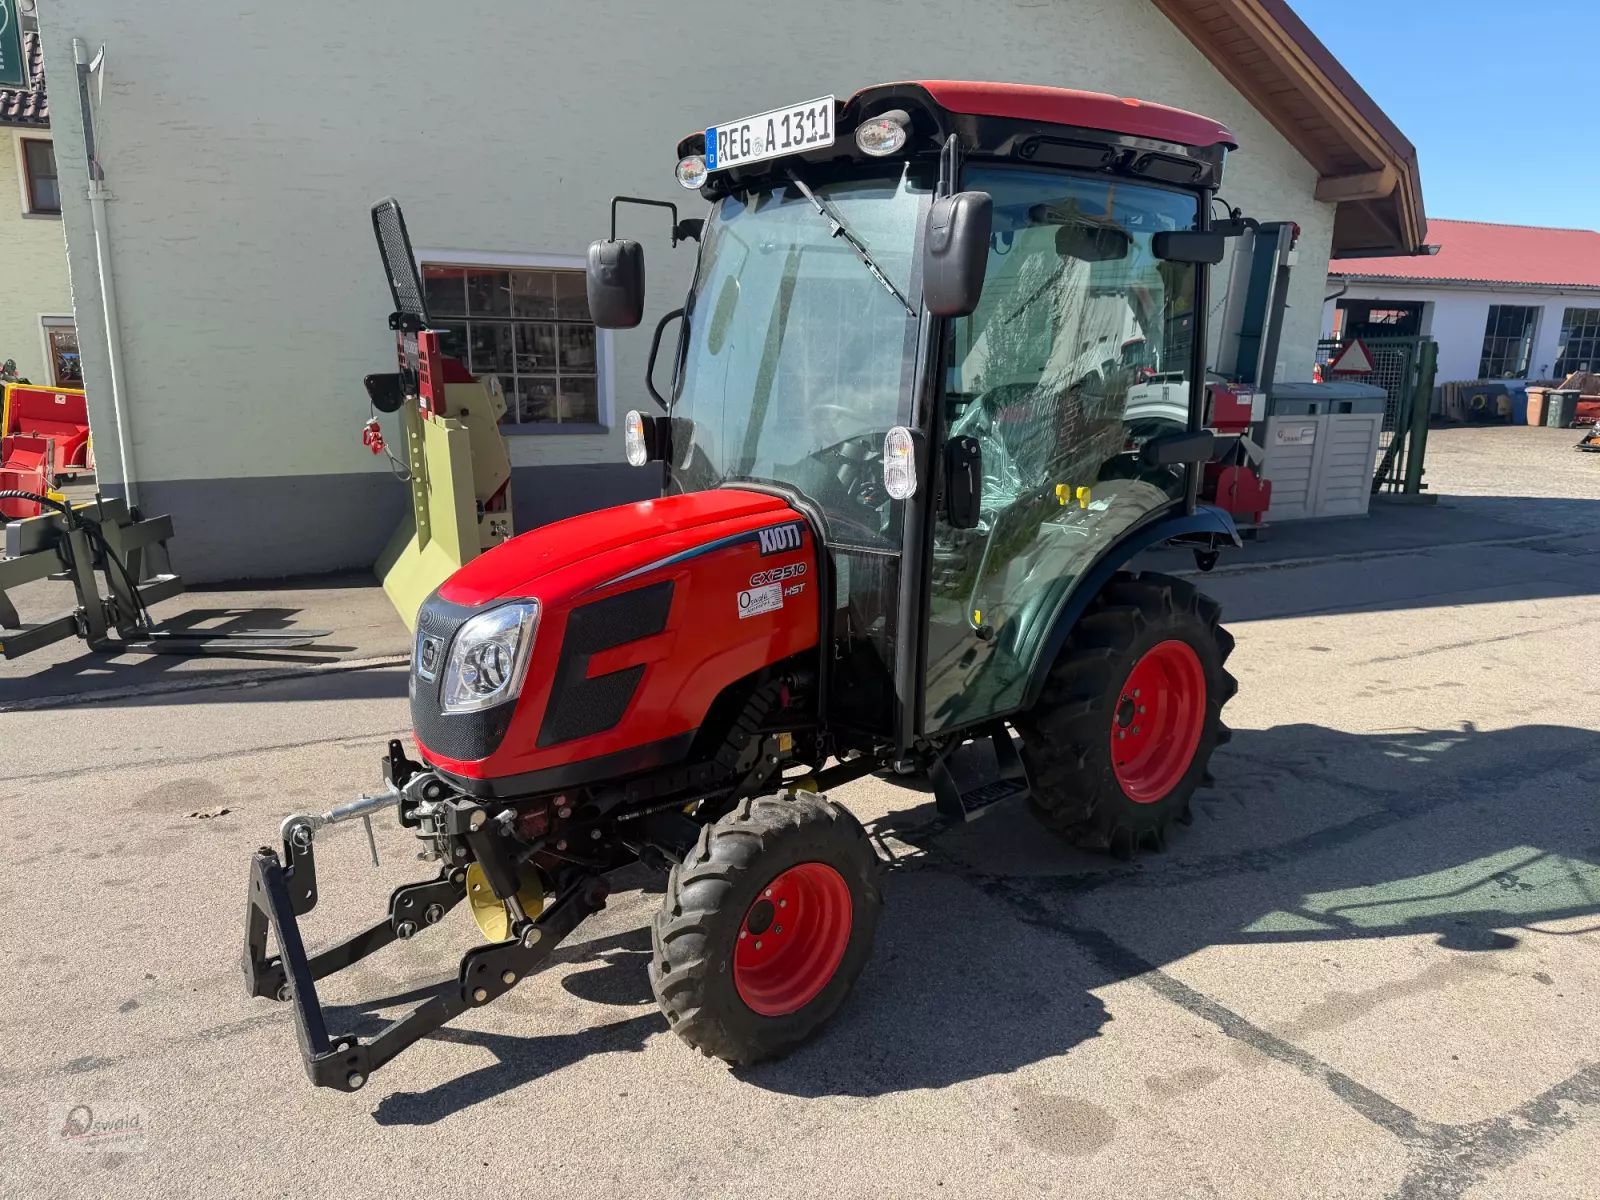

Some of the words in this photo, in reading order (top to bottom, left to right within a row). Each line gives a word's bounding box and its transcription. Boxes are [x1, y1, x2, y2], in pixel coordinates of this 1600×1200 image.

[718, 124, 751, 163] REG
[765, 118, 776, 152] A
[781, 104, 830, 148] 1311
[758, 524, 801, 554] KIOTI
[750, 562, 807, 586] CX2510
[784, 583, 806, 597] HST
